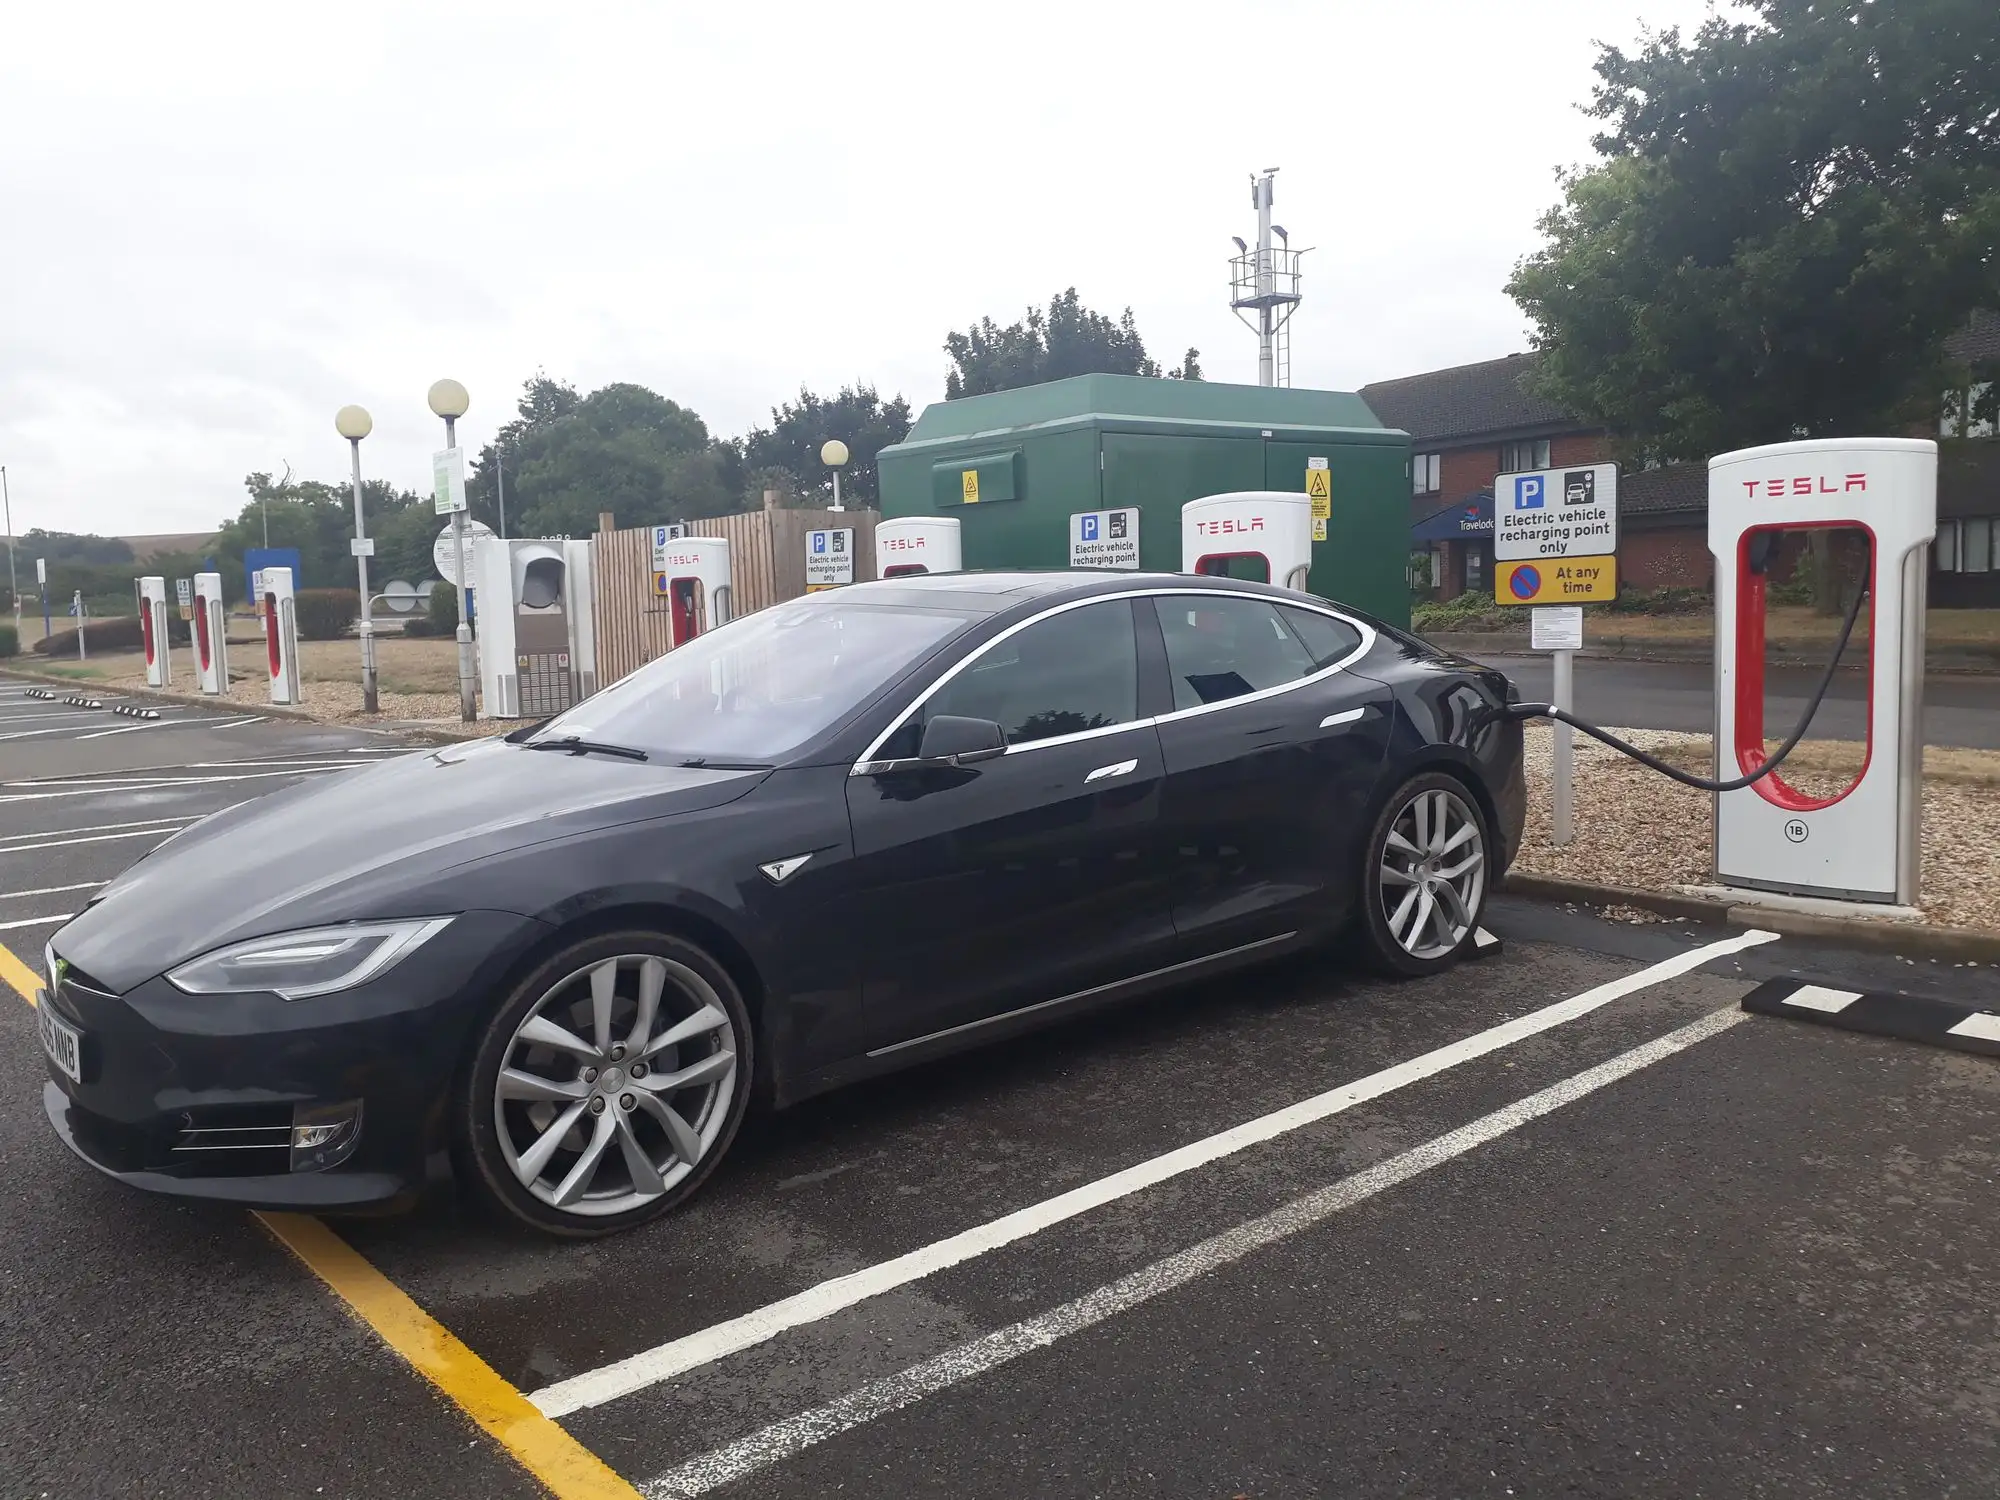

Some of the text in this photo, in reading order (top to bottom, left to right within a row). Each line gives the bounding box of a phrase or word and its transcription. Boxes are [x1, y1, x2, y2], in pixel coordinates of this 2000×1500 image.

[1743, 474, 1866, 498] TESLA
[1521, 480, 1539, 507] P
[1504, 508, 1606, 527] Electric vehicle
[1197, 517, 1264, 535] TESLA
[1500, 522, 1610, 541] recharging point
[883, 537, 925, 550] TESLA
[1075, 541, 1134, 554] Electric vehicle
[1540, 541, 1568, 554] only
[668, 554, 699, 565] TESLA
[809, 554, 849, 564] Electric vehicle
[1073, 552, 1136, 566] recharging point
[1556, 567, 1600, 580] At any
[1563, 581, 1593, 594] time
[1789, 825, 1803, 836] 1B
